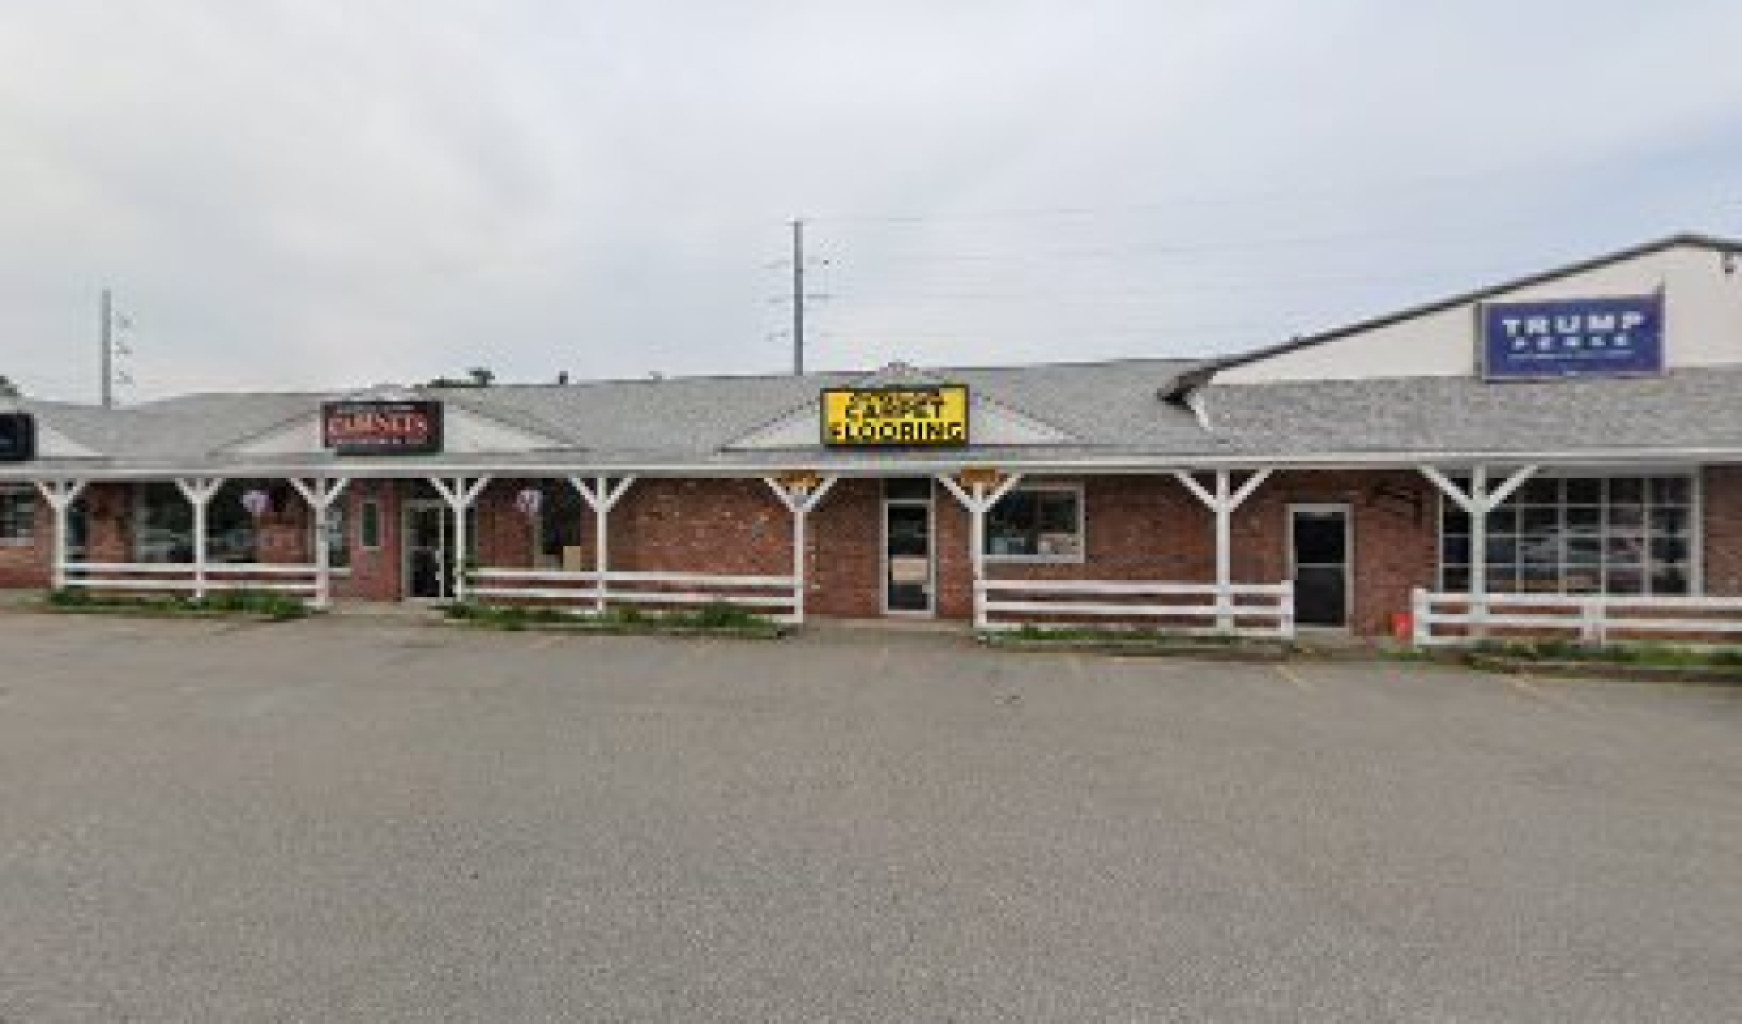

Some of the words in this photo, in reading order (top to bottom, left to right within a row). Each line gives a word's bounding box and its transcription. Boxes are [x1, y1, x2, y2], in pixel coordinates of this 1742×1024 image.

[1502, 311, 1645, 337] TRUMP
[845, 401, 943, 419] CARPET
[828, 421, 963, 440] FLOORING
